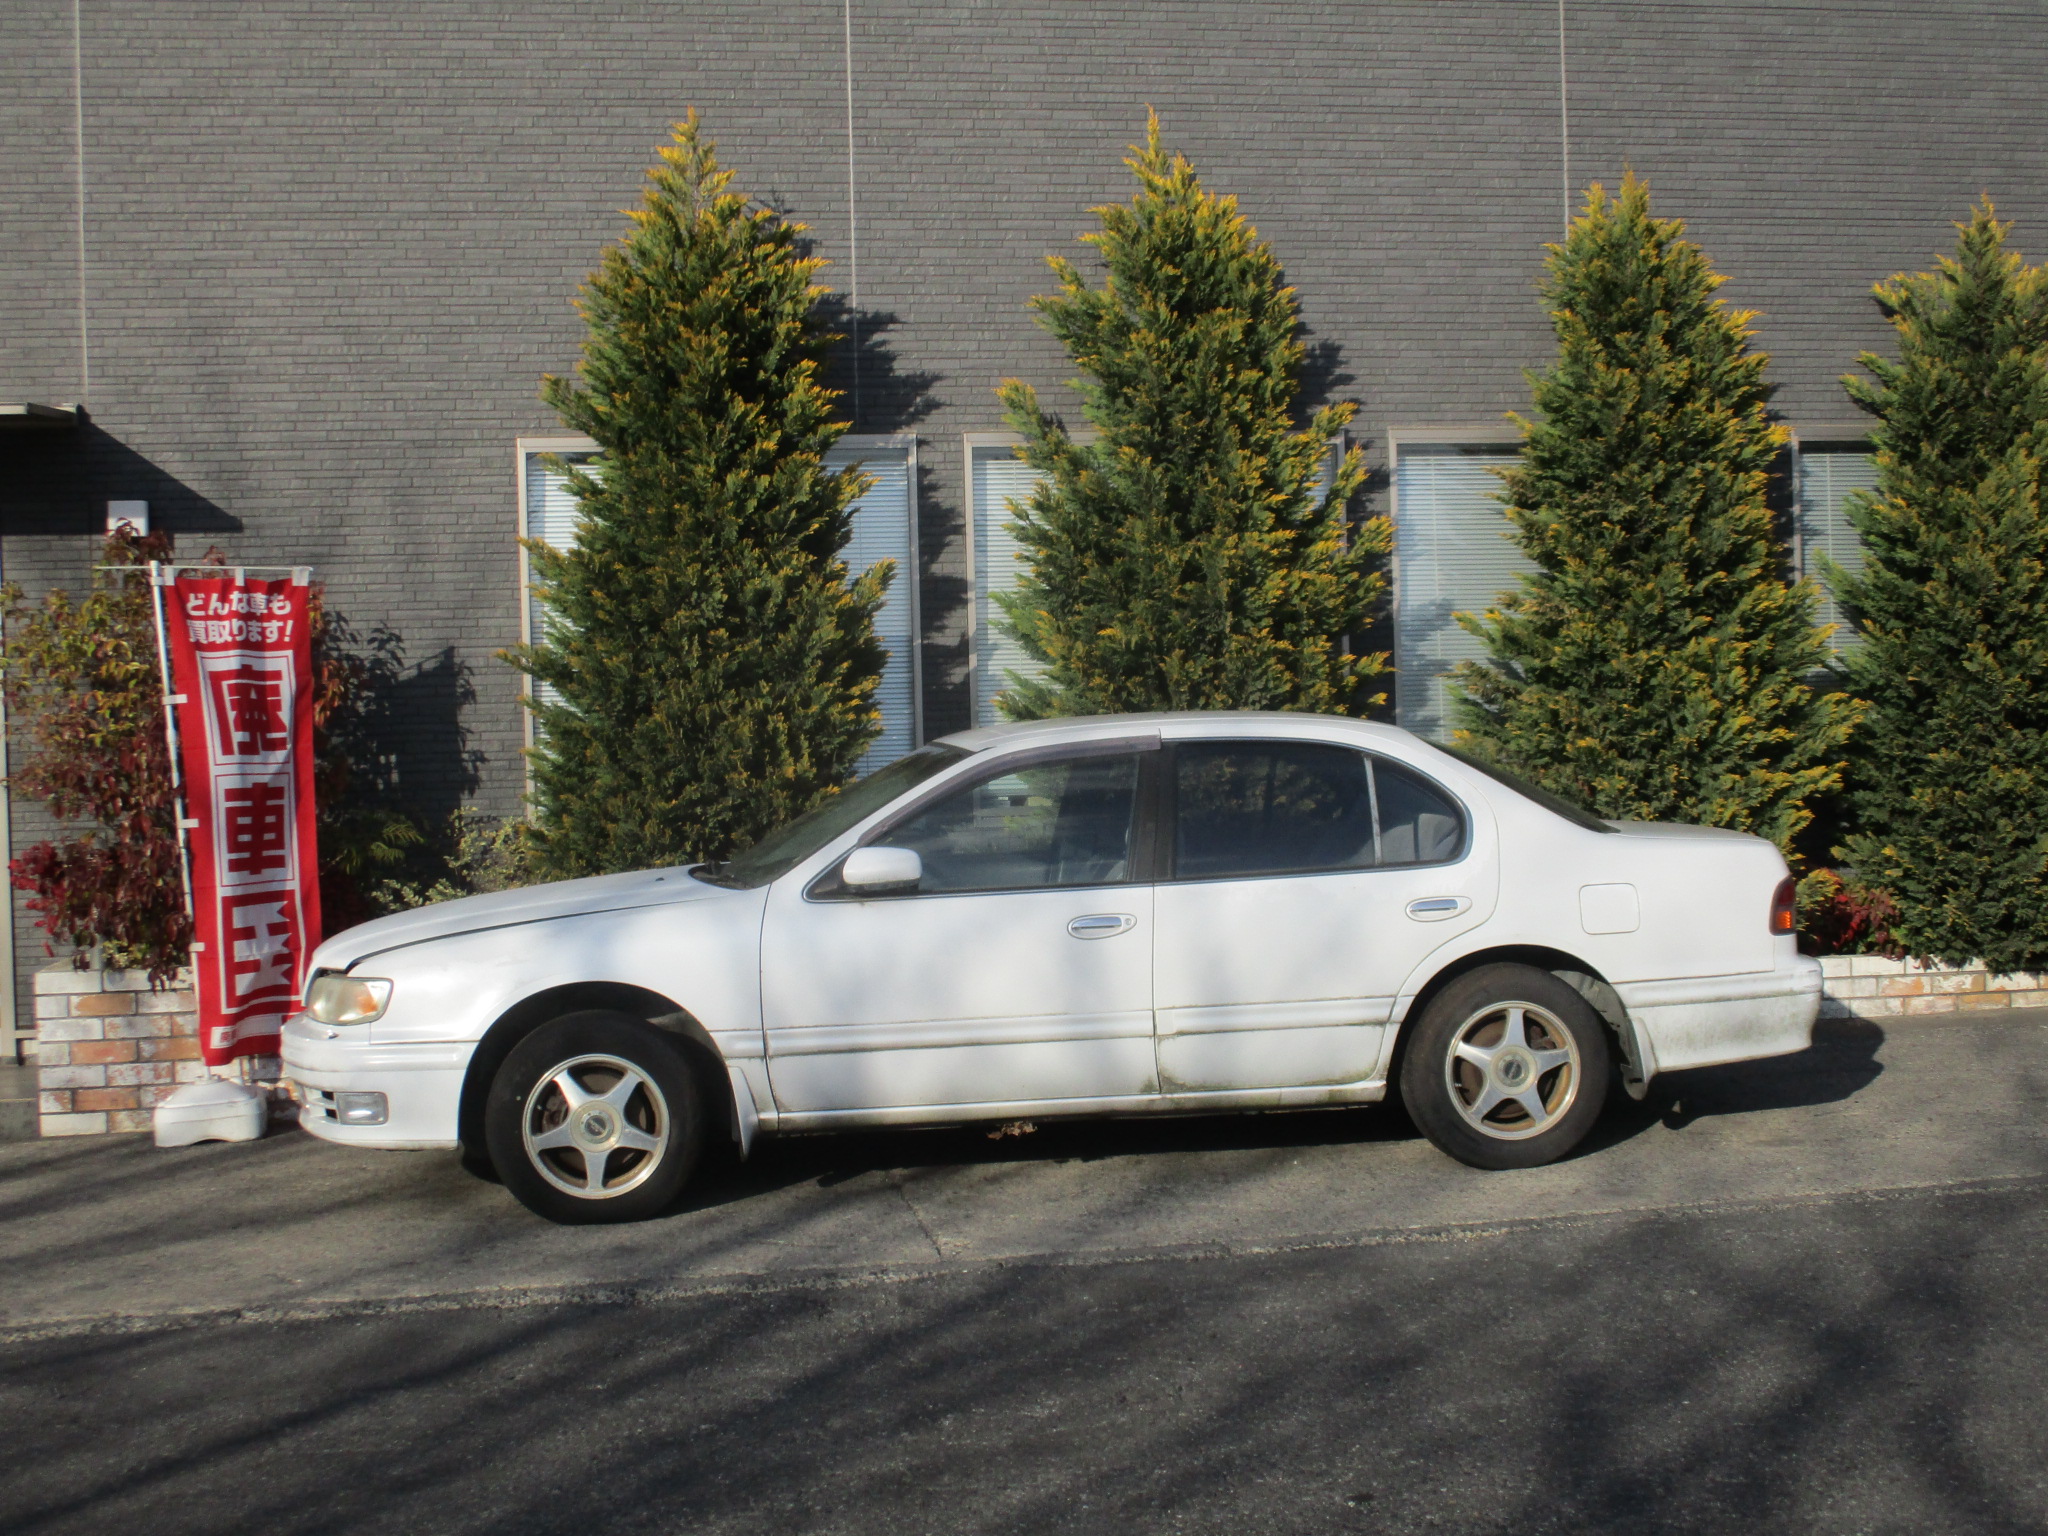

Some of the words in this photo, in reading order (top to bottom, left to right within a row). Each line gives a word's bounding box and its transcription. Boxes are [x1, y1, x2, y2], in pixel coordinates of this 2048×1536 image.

[186, 591, 291, 616] どんな車も
